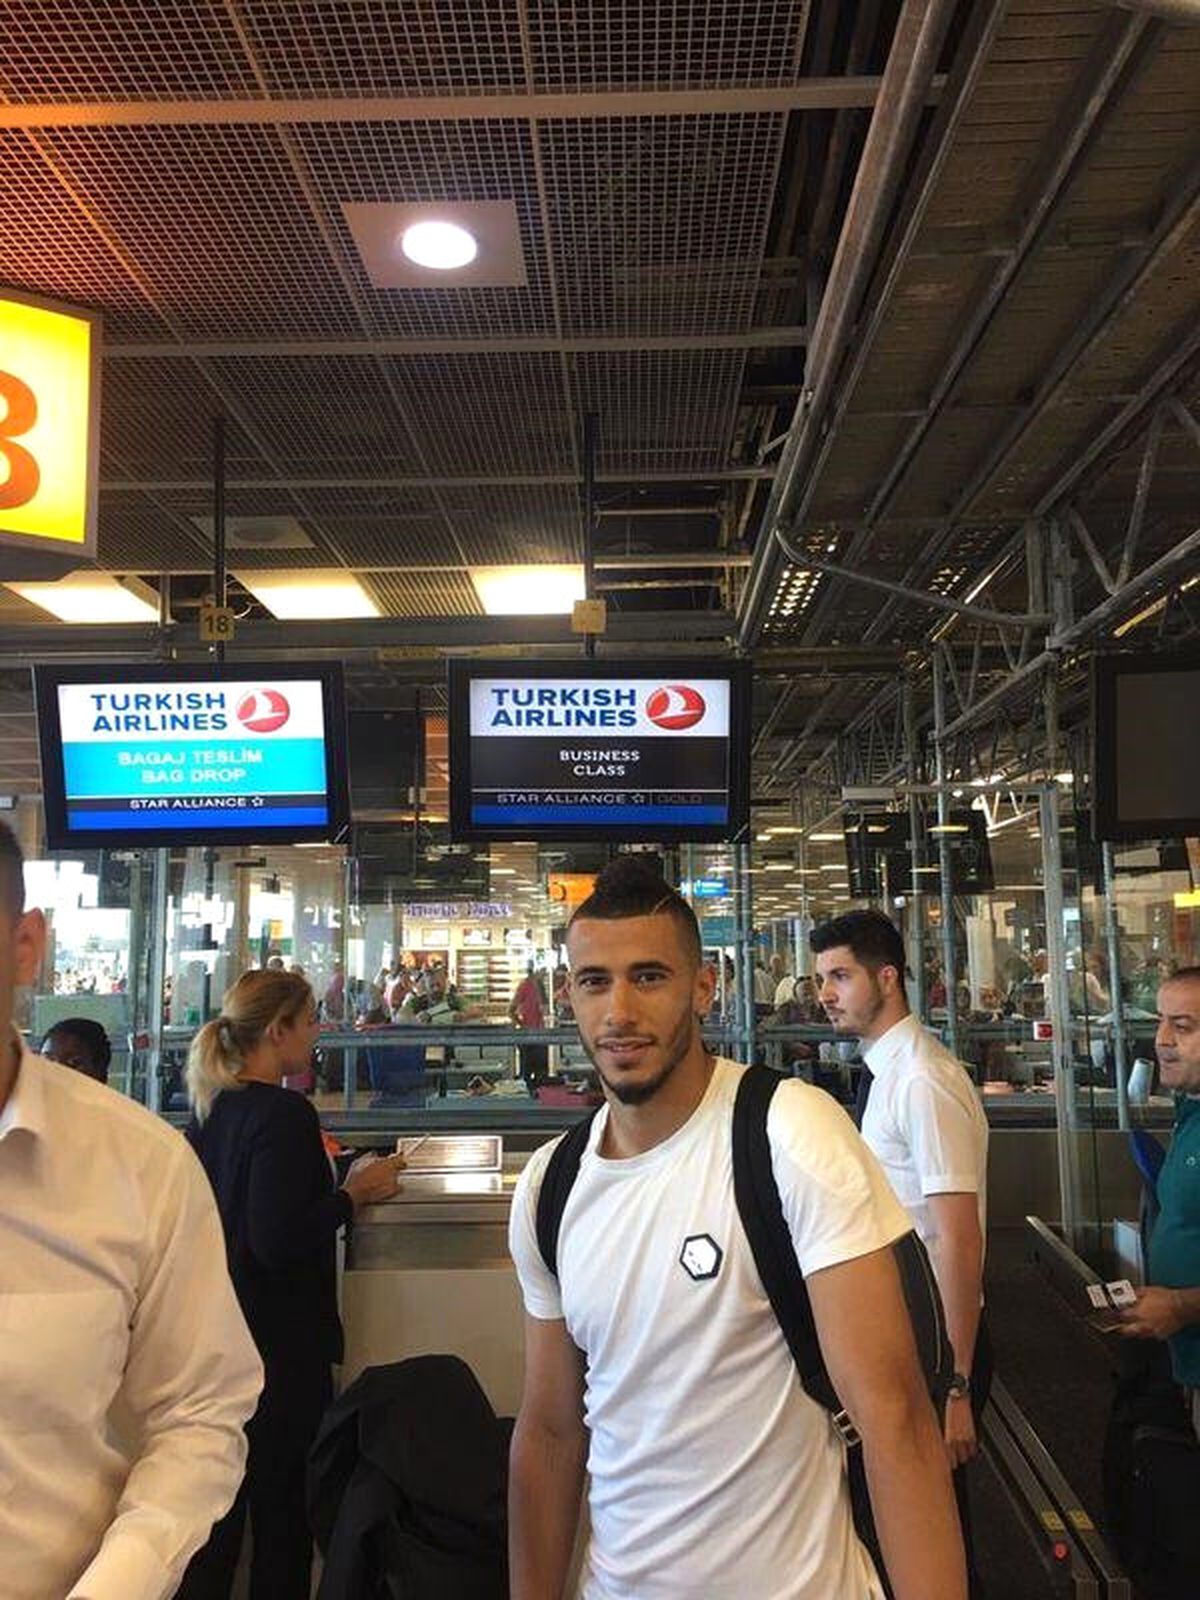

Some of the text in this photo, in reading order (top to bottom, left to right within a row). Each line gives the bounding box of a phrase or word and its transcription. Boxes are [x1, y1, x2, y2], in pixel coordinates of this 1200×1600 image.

[205, 616, 229, 634] 18
[91, 694, 225, 711] TURKISH
[491, 688, 636, 706] TURKISH
[92, 713, 228, 732] AIRLINES
[491, 709, 637, 727] AIRLINES
[118, 746, 263, 765] BAGAJ TESLİM
[559, 750, 640, 762] BUSINESS
[142, 768, 246, 784] BAG DROP
[573, 765, 626, 776] CLASS
[130, 797, 247, 809] STAR ALLIANCE
[497, 794, 539, 805] STAR
[543, 793, 625, 805] ALLIANCE
